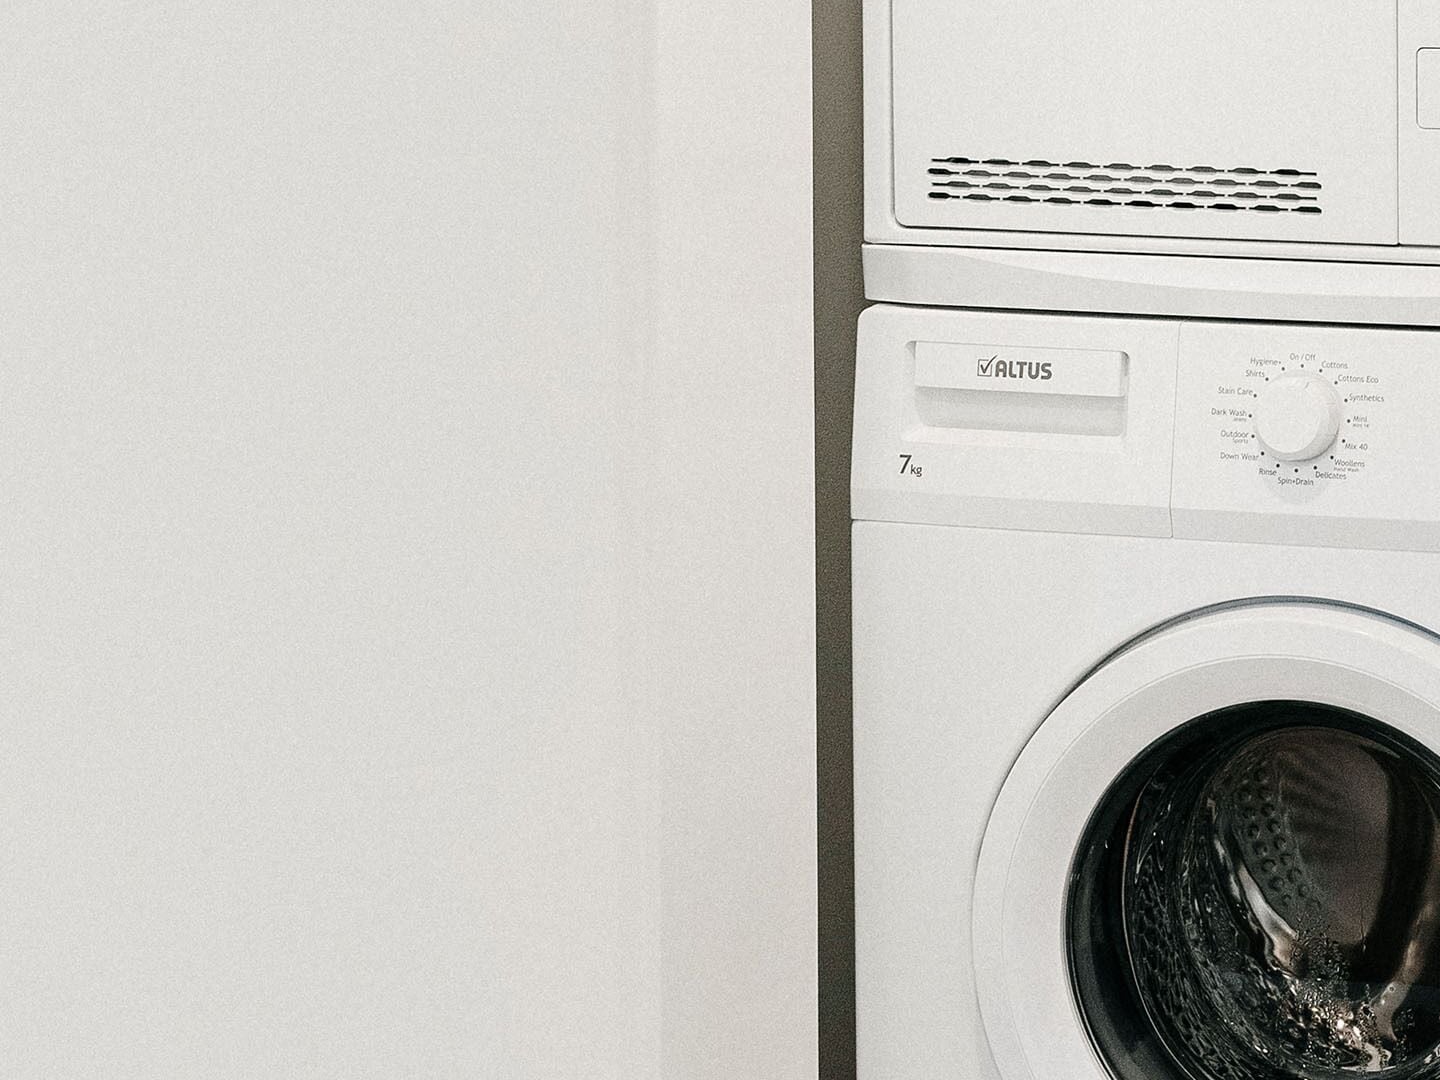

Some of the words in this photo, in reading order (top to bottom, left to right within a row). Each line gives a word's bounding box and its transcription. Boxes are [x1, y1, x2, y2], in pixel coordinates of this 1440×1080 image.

[1289, 353, 1299, 361] On
[1305, 353, 1317, 361] Off
[1321, 360, 1349, 369] Cottons
[994, 359, 1052, 380] ALTUS
[1245, 369, 1266, 378] Shirts
[1338, 374, 1365, 383] Cottons
[1366, 375, 1379, 384] Eco
[1218, 386, 1235, 395] Stain
[1237, 387, 1253, 396] Care
[1349, 393, 1385, 403] Synthetics
[1211, 408, 1227, 416] Dark
[1229, 408, 1247, 417] Wash
[1353, 415, 1368, 423] Mini
[1220, 430, 1249, 438] Outdoor
[1359, 443, 1369, 451] 40
[1220, 451, 1240, 460] Down
[1241, 452, 1259, 461] Wear
[1334, 458, 1365, 468] Woollens
[1258, 467, 1277, 476] Rinse
[1315, 471, 1347, 480] Delicates
